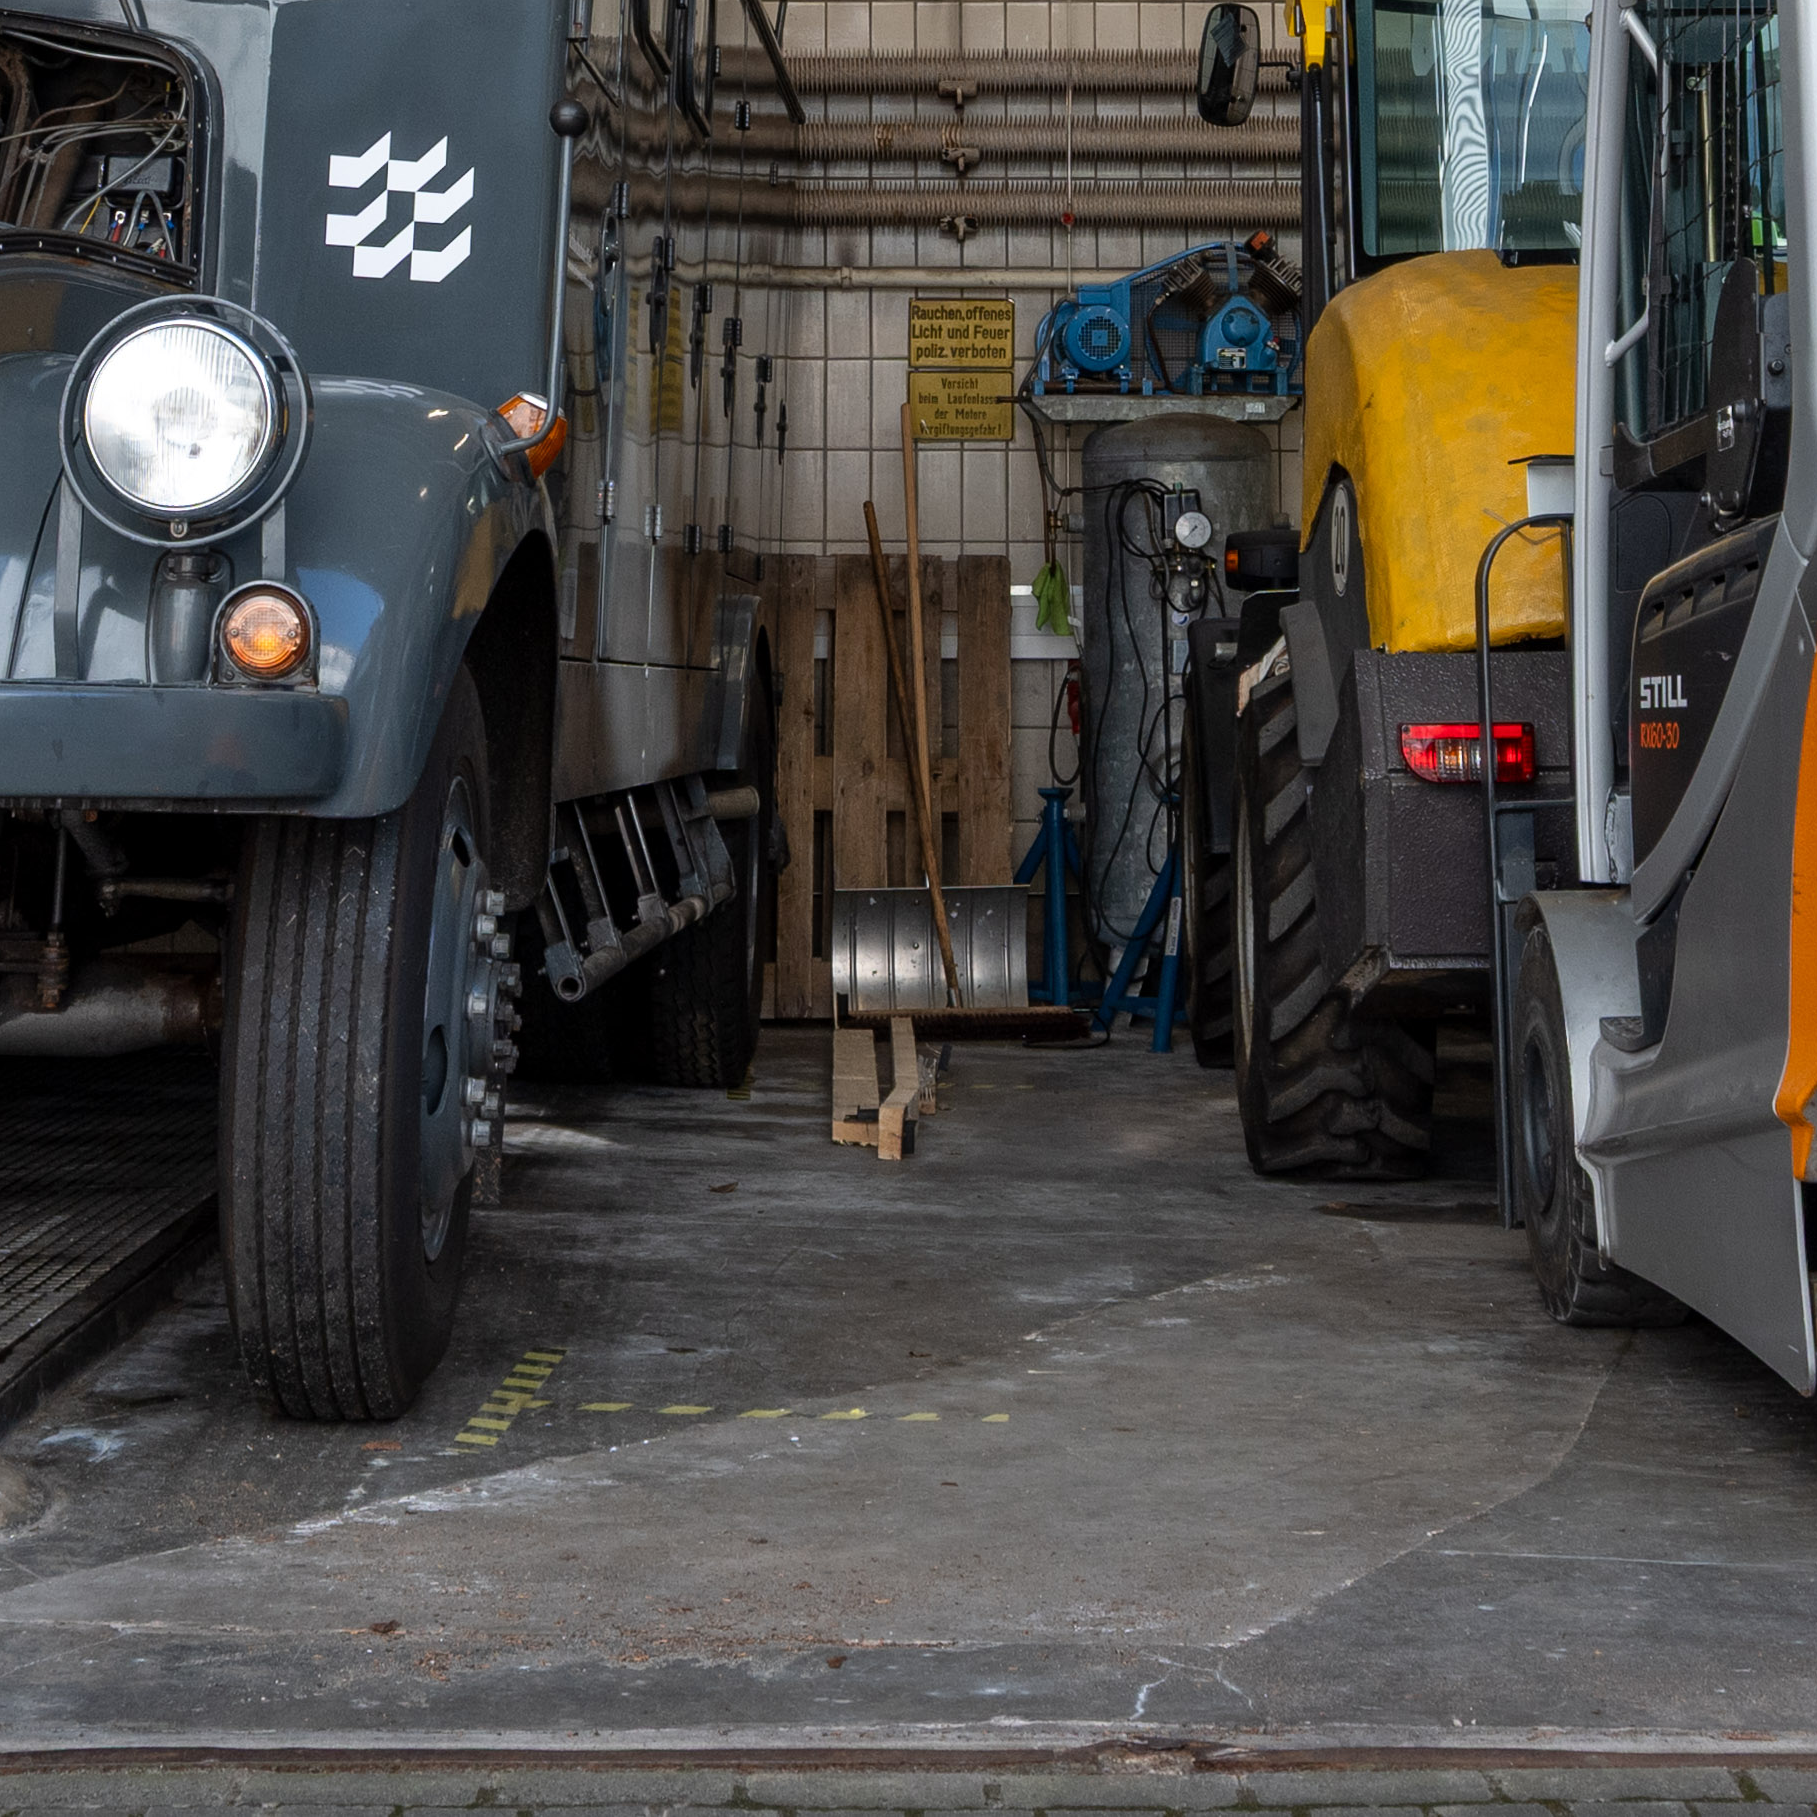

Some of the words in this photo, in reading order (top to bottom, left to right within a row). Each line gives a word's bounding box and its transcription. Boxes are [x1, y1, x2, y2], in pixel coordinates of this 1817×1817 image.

[912, 324, 943, 339] Licht
[947, 324, 970, 339] und
[973, 325, 1010, 340] Feuer
[916, 344, 948, 361] poliz.
[950, 344, 1006, 359] verboten
[941, 378, 979, 389] Vorsicht
[918, 392, 938, 404] beim
[947, 392, 1001, 405] Laufenlass
[934, 408, 949, 420] der
[955, 408, 988, 420] Motore
[1640, 674, 1688, 709] STILL
